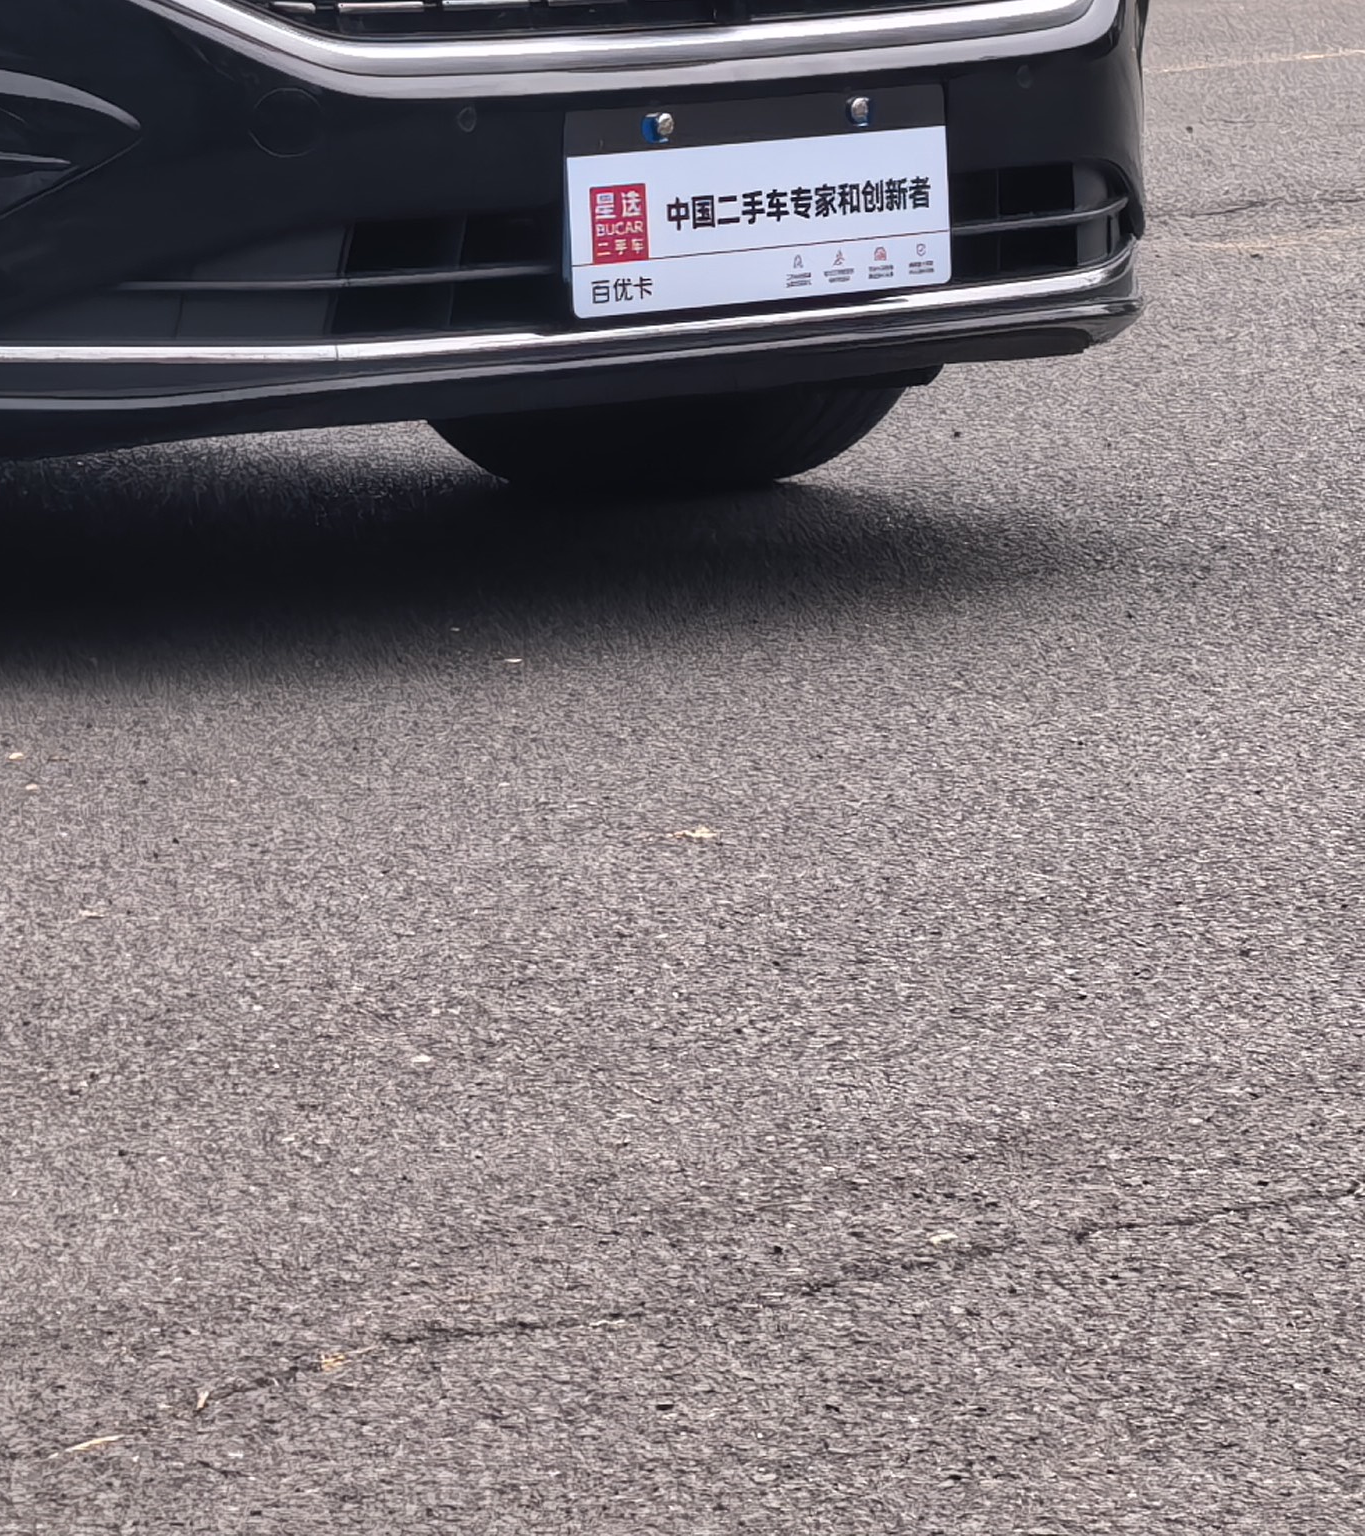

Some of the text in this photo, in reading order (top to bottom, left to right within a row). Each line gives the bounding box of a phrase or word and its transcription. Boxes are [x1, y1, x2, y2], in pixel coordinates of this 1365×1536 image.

[666, 176, 931, 231] 中国二手车专家和创新者
[596, 221, 644, 237] BUCAR
[597, 238, 645, 257] 二手车
[591, 276, 654, 304] 百优卡
